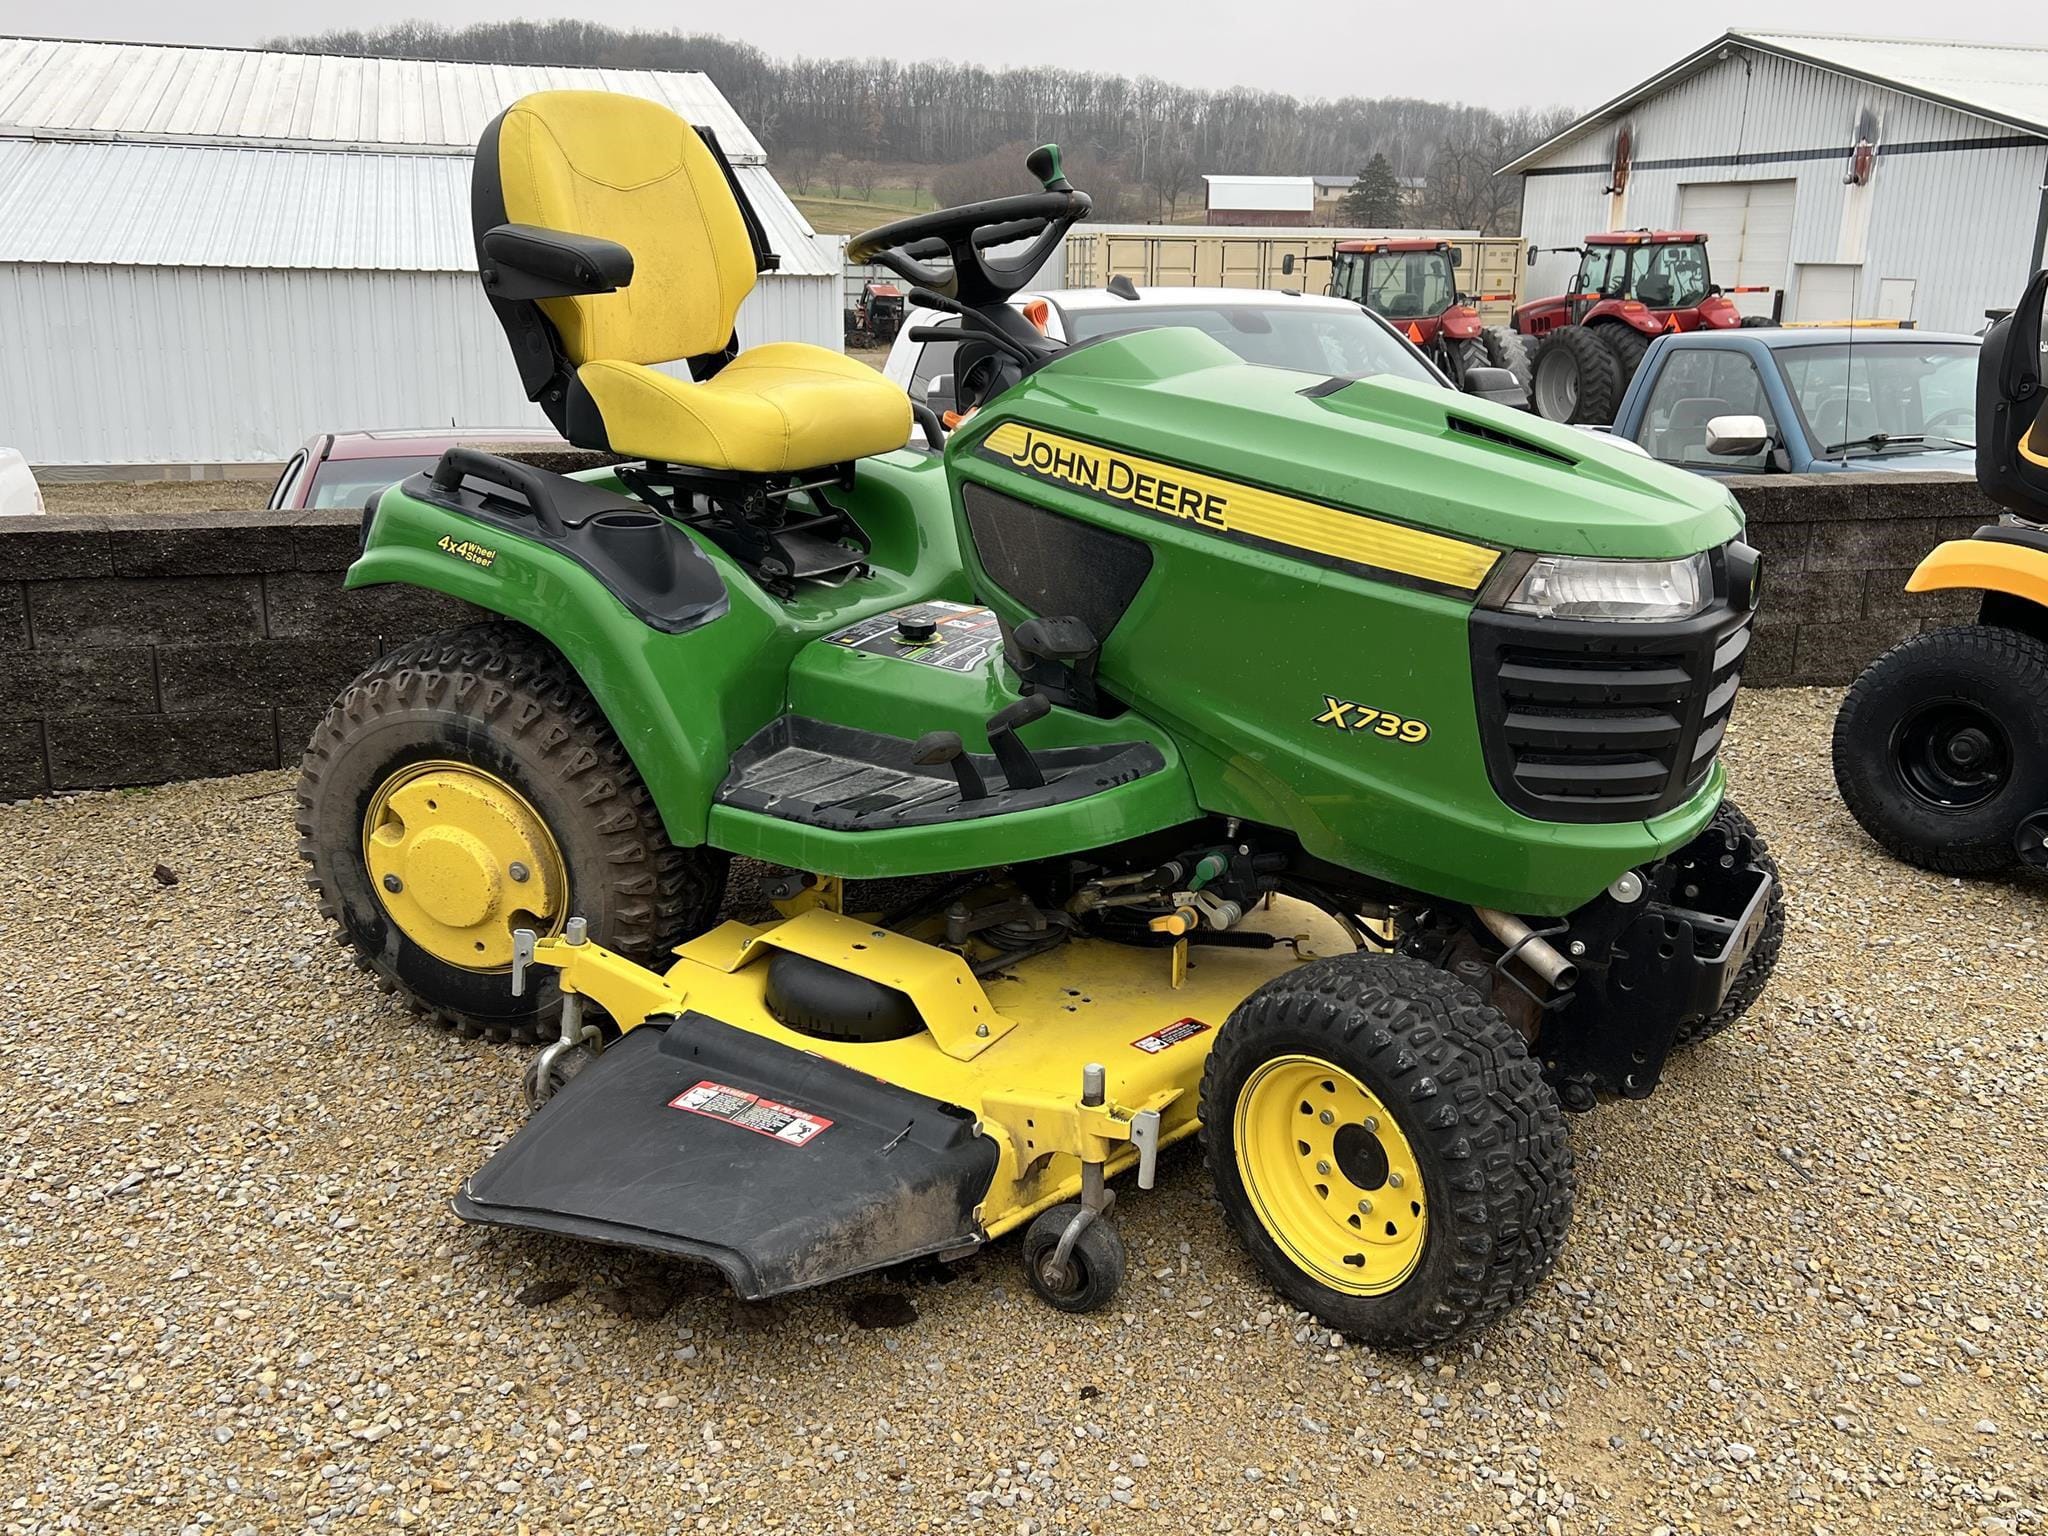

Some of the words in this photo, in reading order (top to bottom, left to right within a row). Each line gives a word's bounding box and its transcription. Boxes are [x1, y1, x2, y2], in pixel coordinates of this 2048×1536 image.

[1012, 431, 1100, 486] JOHN
[1107, 458, 1228, 526] DEERE
[437, 535, 469, 557] 4x4
[468, 542, 497, 559] Wheel
[465, 551, 493, 567] Steer
[1315, 696, 1429, 744] X739
